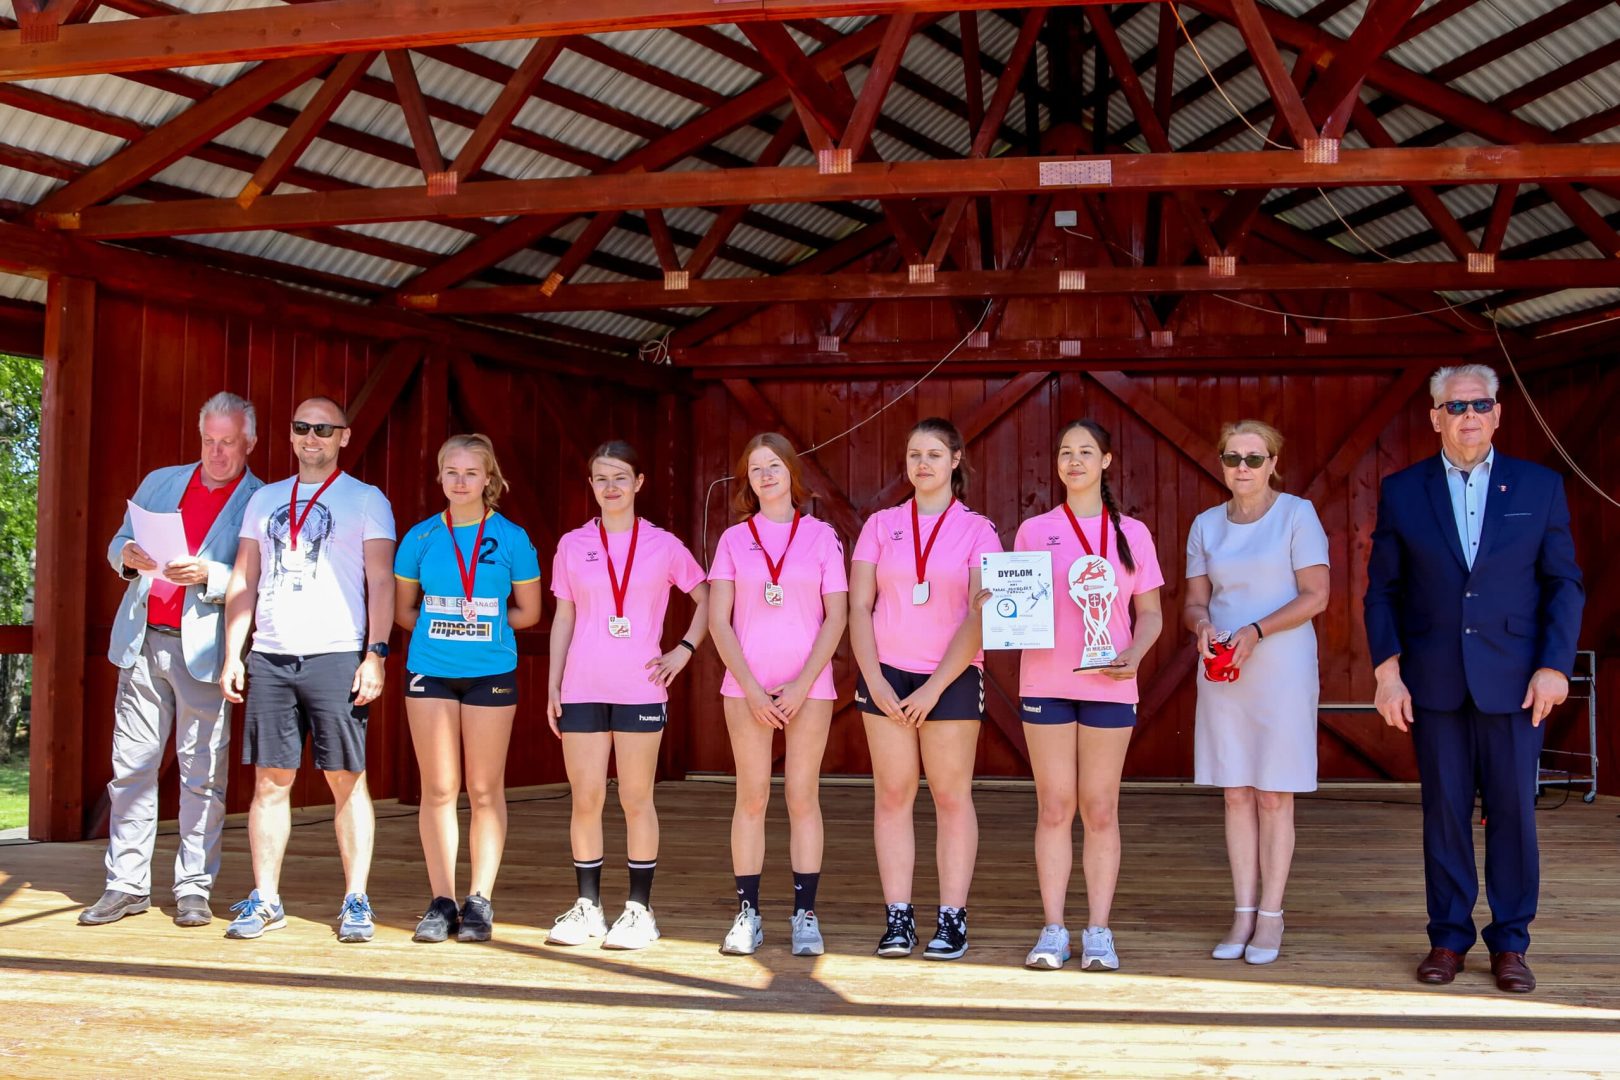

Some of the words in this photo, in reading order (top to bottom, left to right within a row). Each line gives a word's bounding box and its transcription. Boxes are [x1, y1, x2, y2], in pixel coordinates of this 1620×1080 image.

[478, 537, 498, 565] 2
[998, 569, 1033, 578] DYPLOM
[1003, 603, 1010, 611] 3
